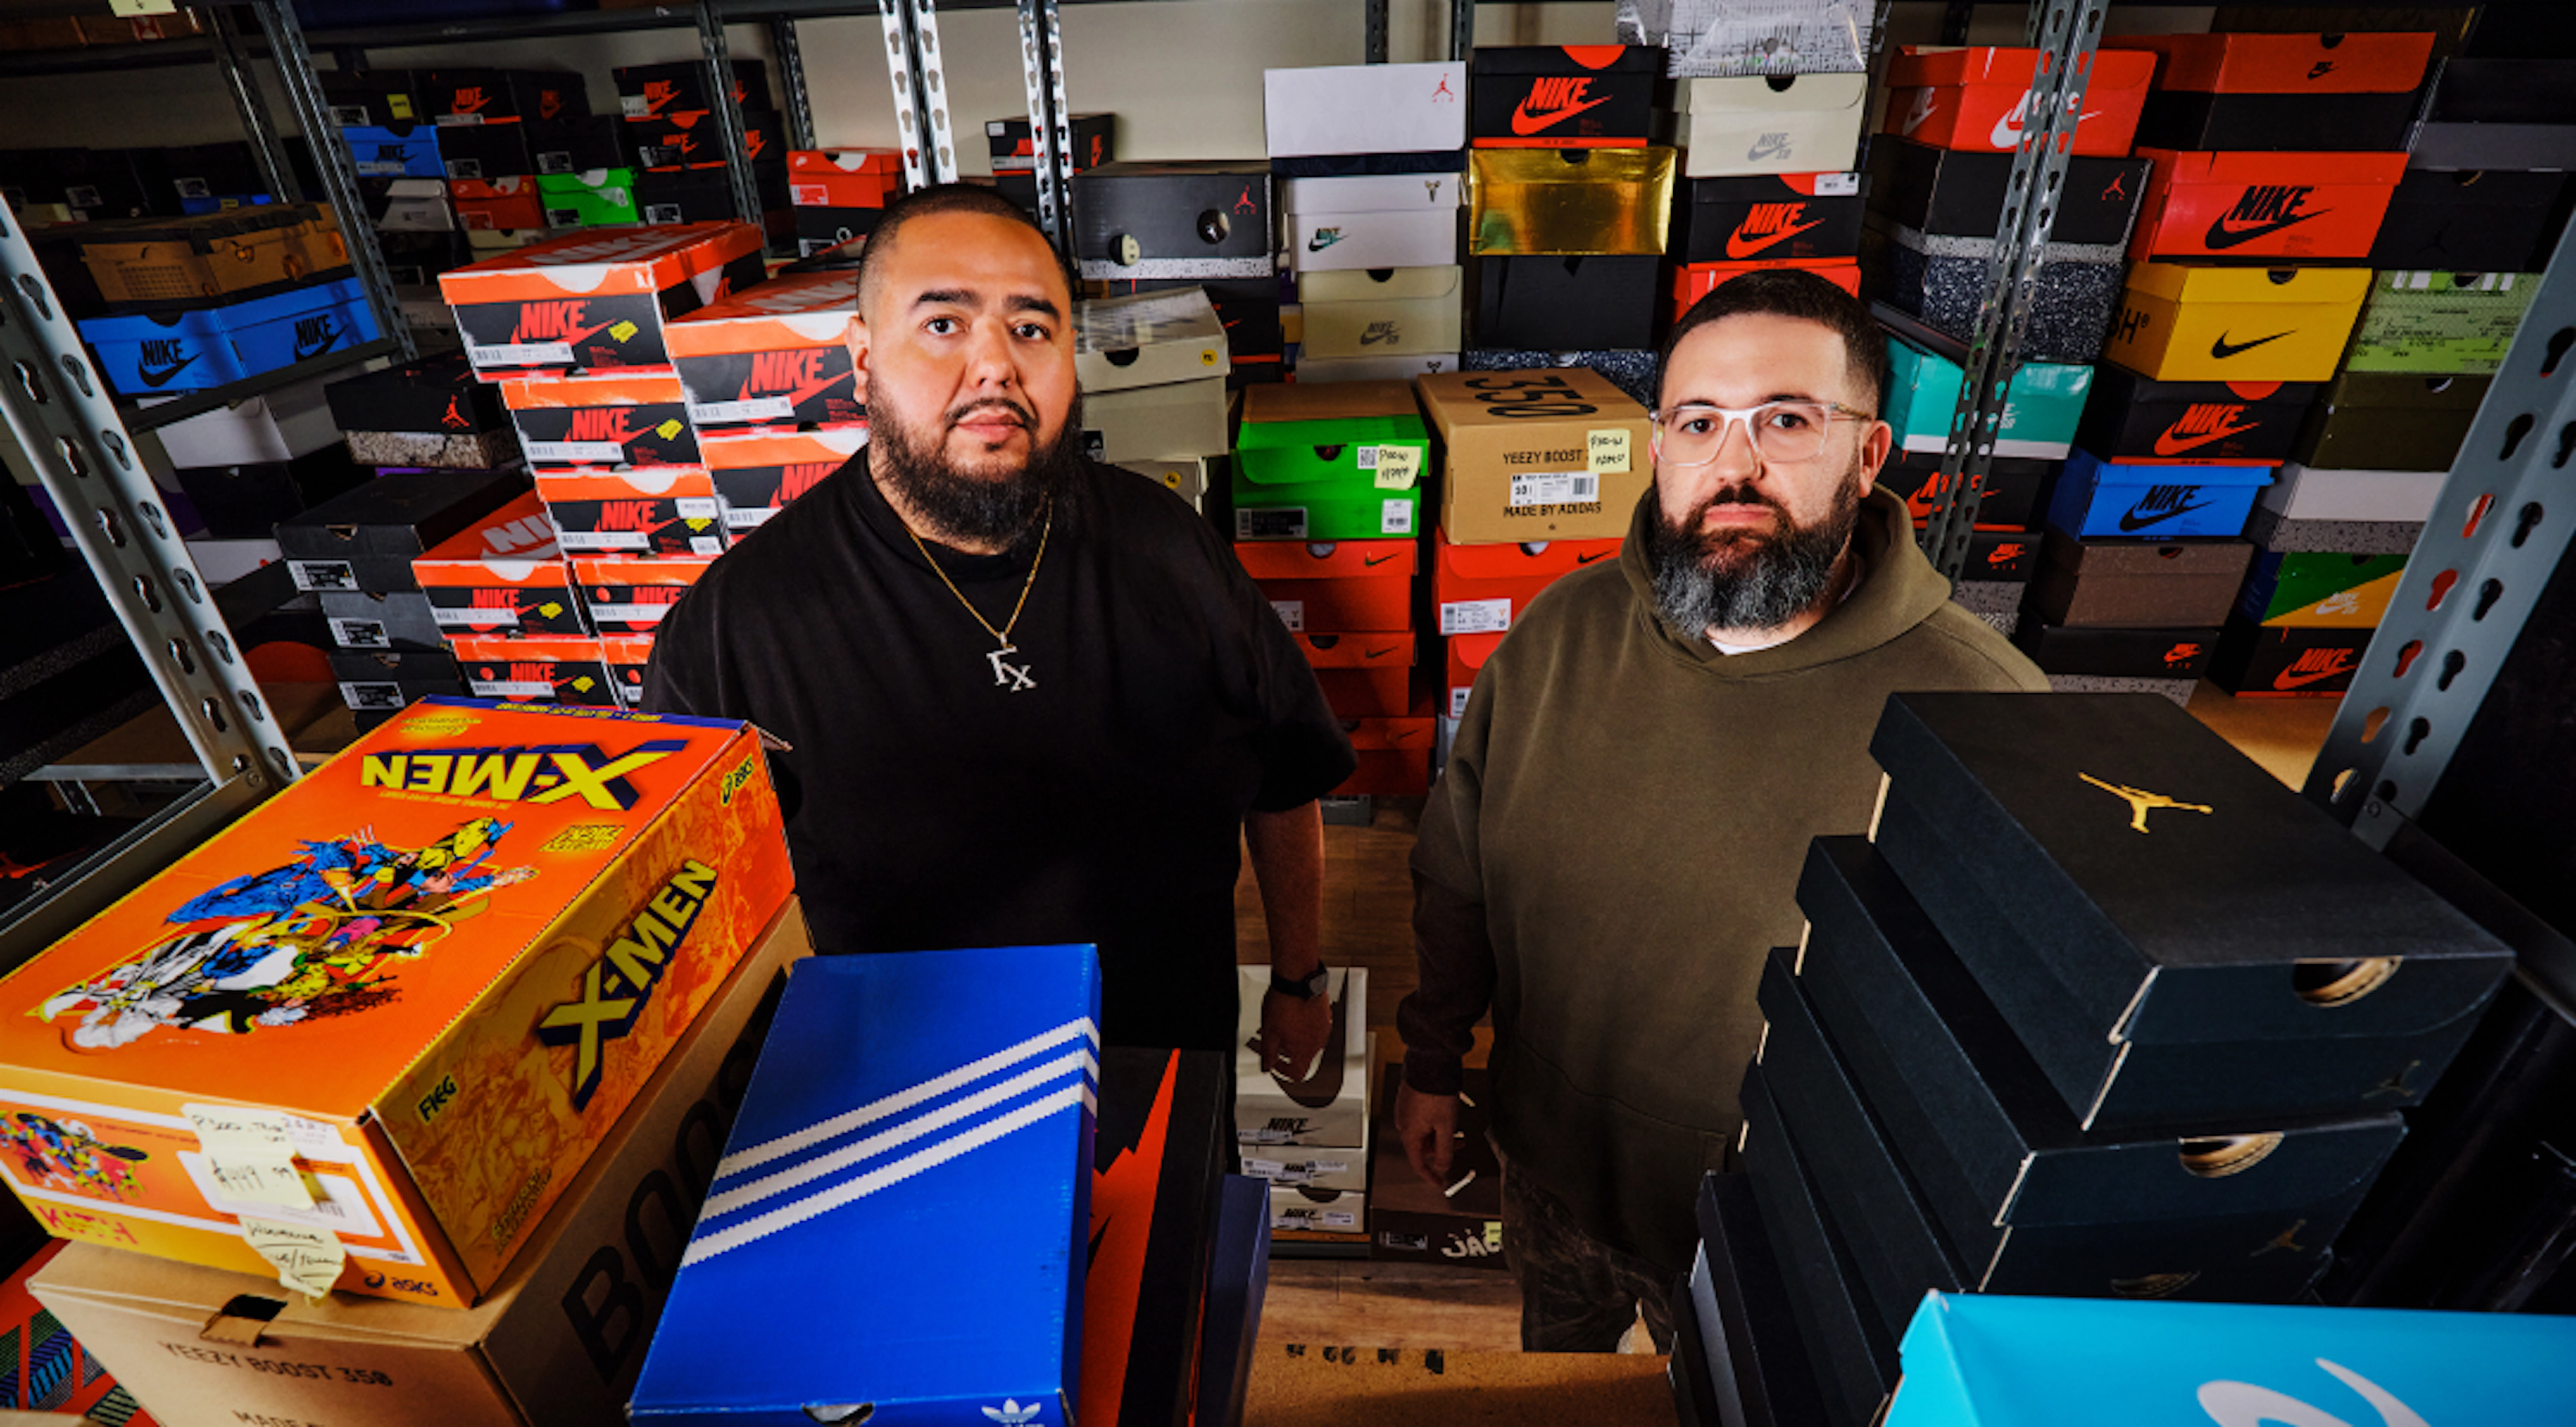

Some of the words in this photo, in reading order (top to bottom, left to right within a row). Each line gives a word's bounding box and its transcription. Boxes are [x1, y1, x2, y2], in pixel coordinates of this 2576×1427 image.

[1525, 76, 1593, 110] NIKE
[1758, 133, 1789, 147] NIKE
[1741, 203, 1807, 234] NIKE
[2226, 186, 2314, 221] NIKE
[294, 314, 332, 349] NIKE
[519, 300, 586, 340] NIKE
[1367, 320, 1395, 333] NIKE
[141, 339, 182, 366] NIKE
[750, 349, 824, 393] NIKE
[572, 407, 629, 441] NIKE
[2174, 403, 2245, 434] NIKE
[1503, 452, 1542, 464] YEEZY
[1544, 449, 1583, 462] BOOST
[1503, 505, 1538, 517] MADE
[1558, 503, 1602, 515] ADIDAS
[2137, 485, 2202, 511] NIKE
[600, 501, 655, 531] NIKE
[472, 588, 520, 611] NIKE
[632, 586, 682, 605] NIKE
[509, 662, 556, 682] NIKE
[2292, 648, 2354, 672] NIKE
[362, 743, 681, 810] X-MEN
[539, 859, 718, 1111] X-MEN
[158, 1342, 242, 1368] YEEZY
[246, 1356, 333, 1380] BOOST
[336, 1367, 394, 1386] 350
